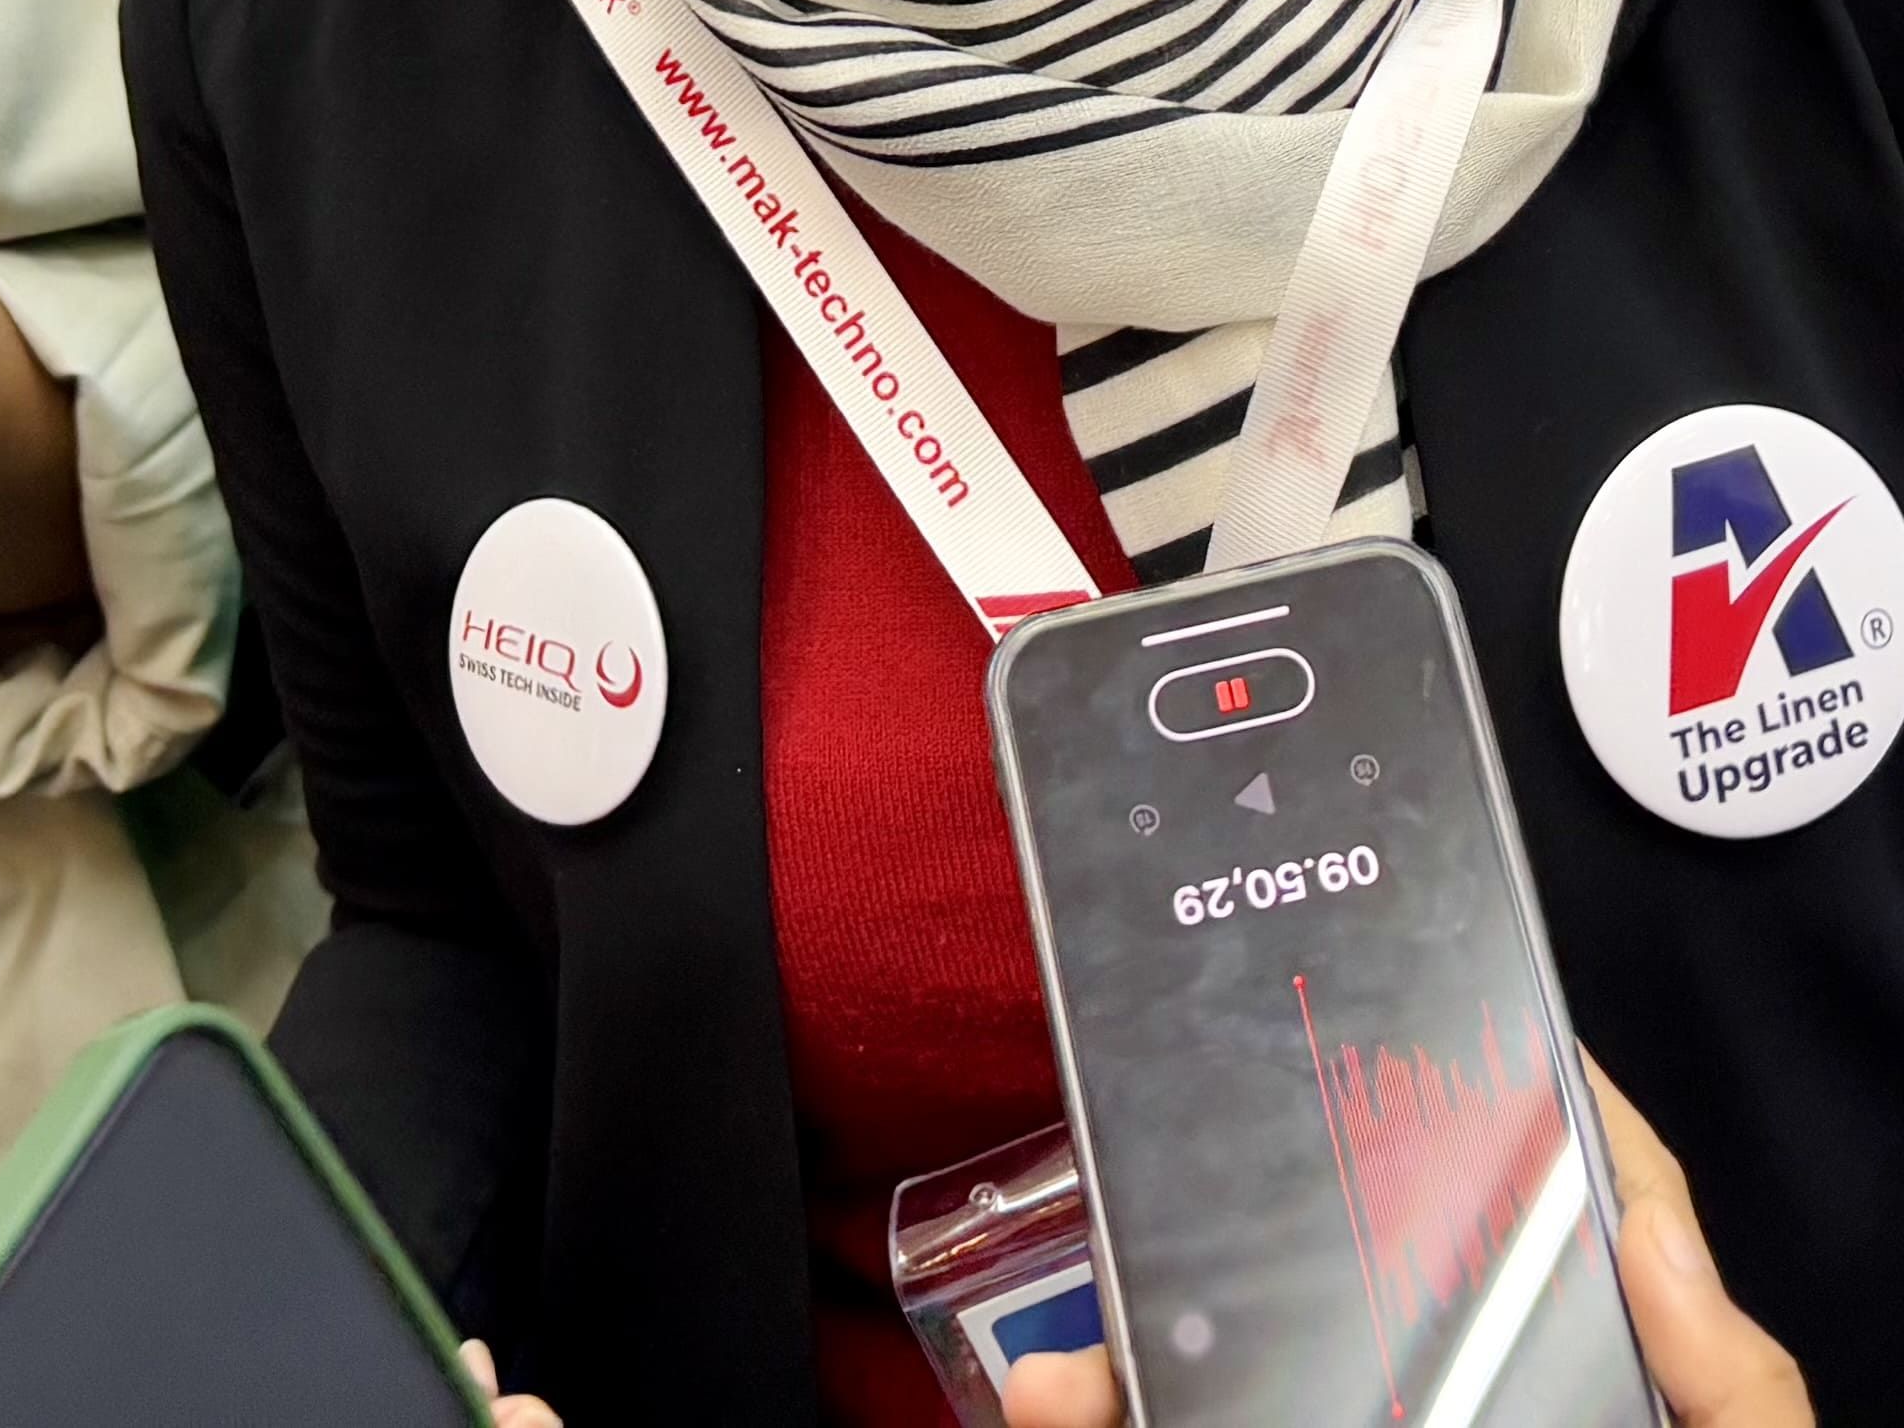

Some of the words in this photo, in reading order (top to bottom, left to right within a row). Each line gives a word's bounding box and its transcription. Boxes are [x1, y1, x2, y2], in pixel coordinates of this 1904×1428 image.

[655, 47, 970, 508] www.mak-techno.com
[458, 652, 498, 682] SWISS
[500, 668, 533, 693] TECH
[536, 681, 582, 712] INSIDE
[462, 609, 582, 692] HEIQ
[1669, 714, 1746, 759] The
[1757, 679, 1864, 734] Linen
[1677, 716, 1869, 803] Upgrade
[1172, 844, 1380, 926] 09.50,29
